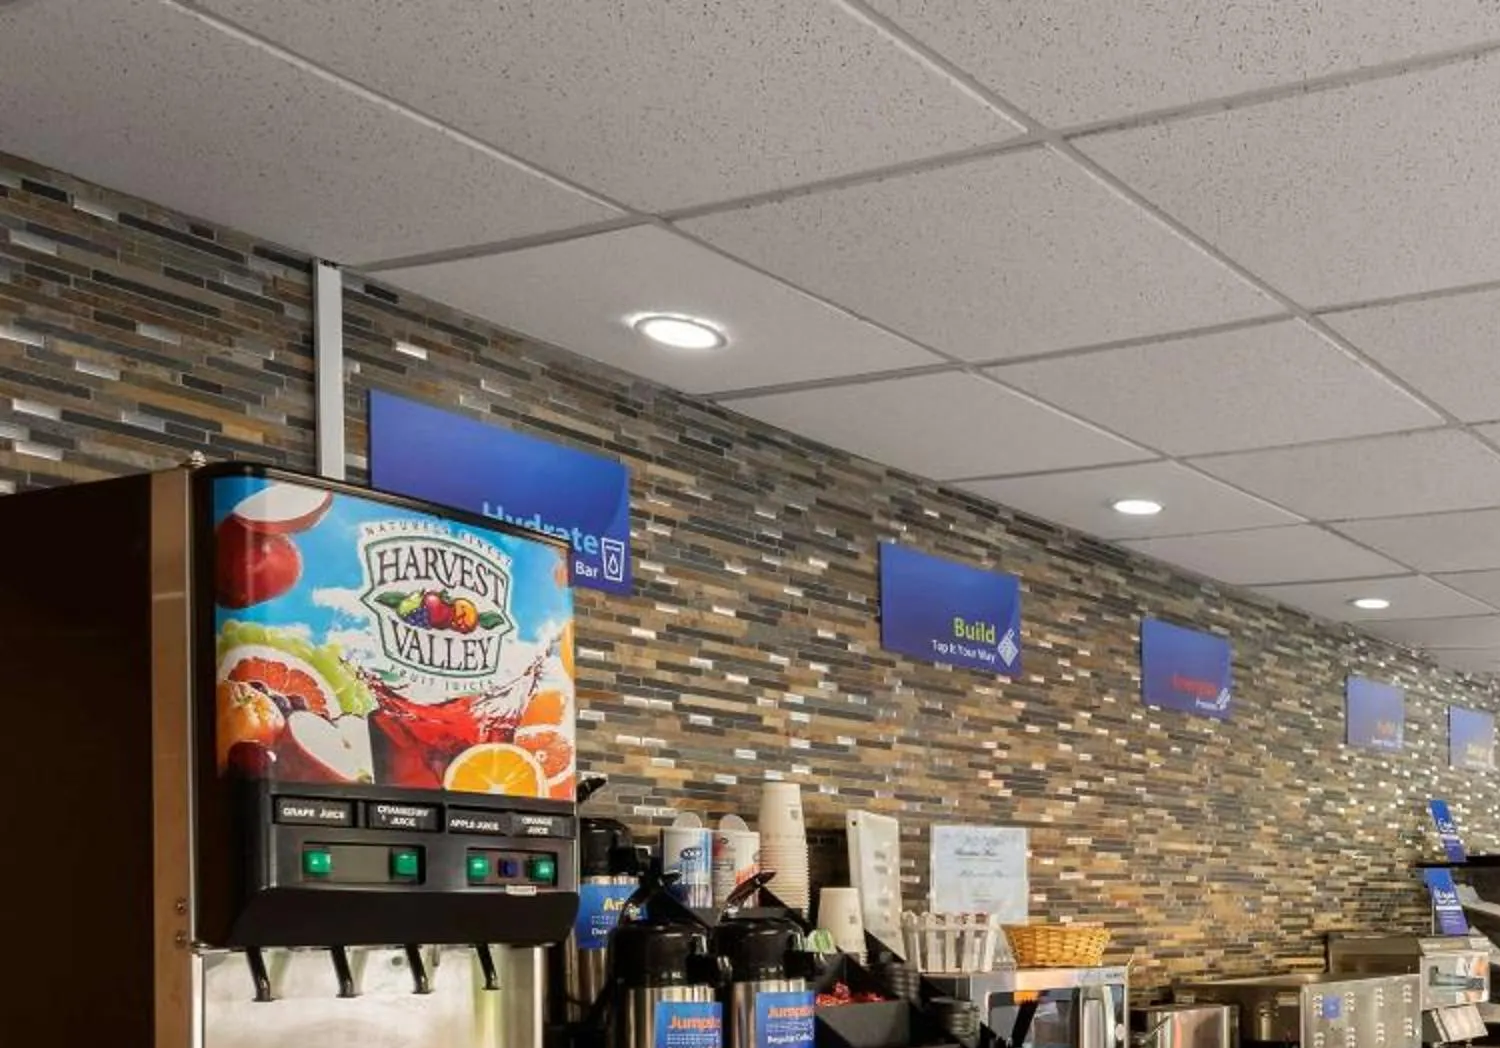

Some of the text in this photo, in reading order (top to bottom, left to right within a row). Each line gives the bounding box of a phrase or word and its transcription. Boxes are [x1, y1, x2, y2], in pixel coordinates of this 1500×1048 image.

[376, 545, 505, 606] HARVEST
[575, 560, 599, 577] Bar
[953, 617, 996, 644] Build
[389, 619, 494, 670] VALLEY
[319, 808, 345, 819] JUICE
[449, 819, 475, 829] APPLE
